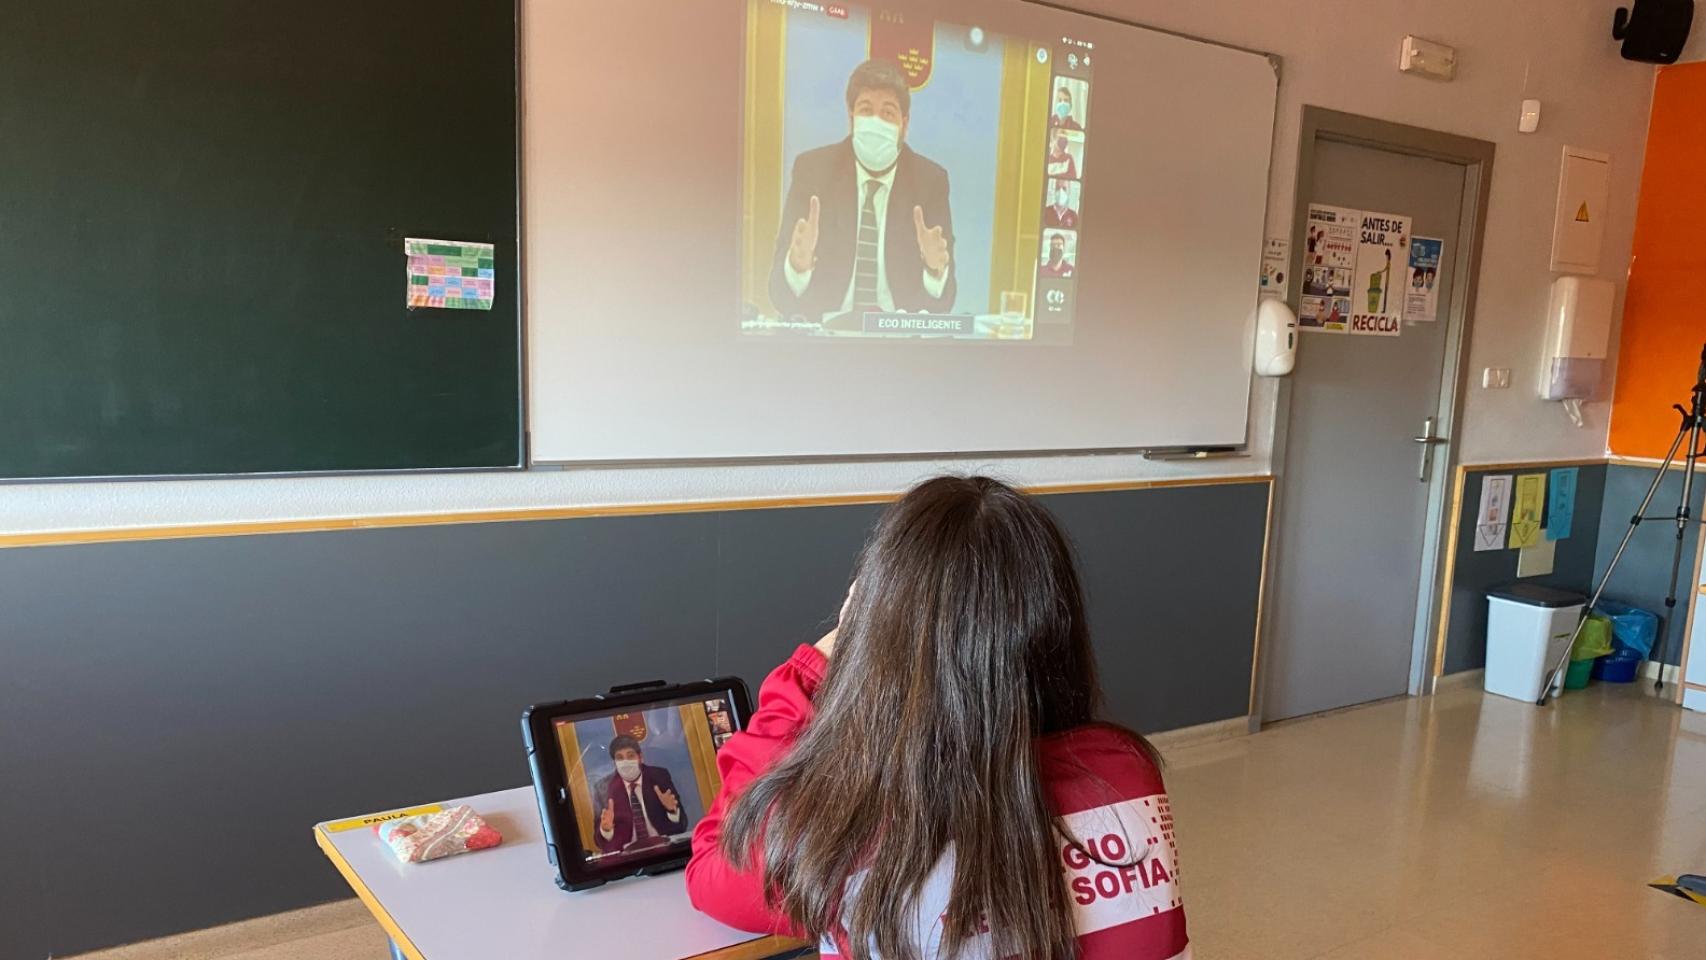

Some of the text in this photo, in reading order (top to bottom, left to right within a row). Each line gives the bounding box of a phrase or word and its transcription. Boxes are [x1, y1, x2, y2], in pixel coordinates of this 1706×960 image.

[1361, 217, 1403, 234] ANTES DE
[1360, 231, 1393, 246] SALIR...
[878, 318, 962, 330] ECO INTELIGENTE
[1352, 314, 1398, 332] RECICLA
[363, 813, 408, 824] PAULA
[1061, 833, 1126, 870] GIO
[1072, 858, 1170, 906] SOFIA
